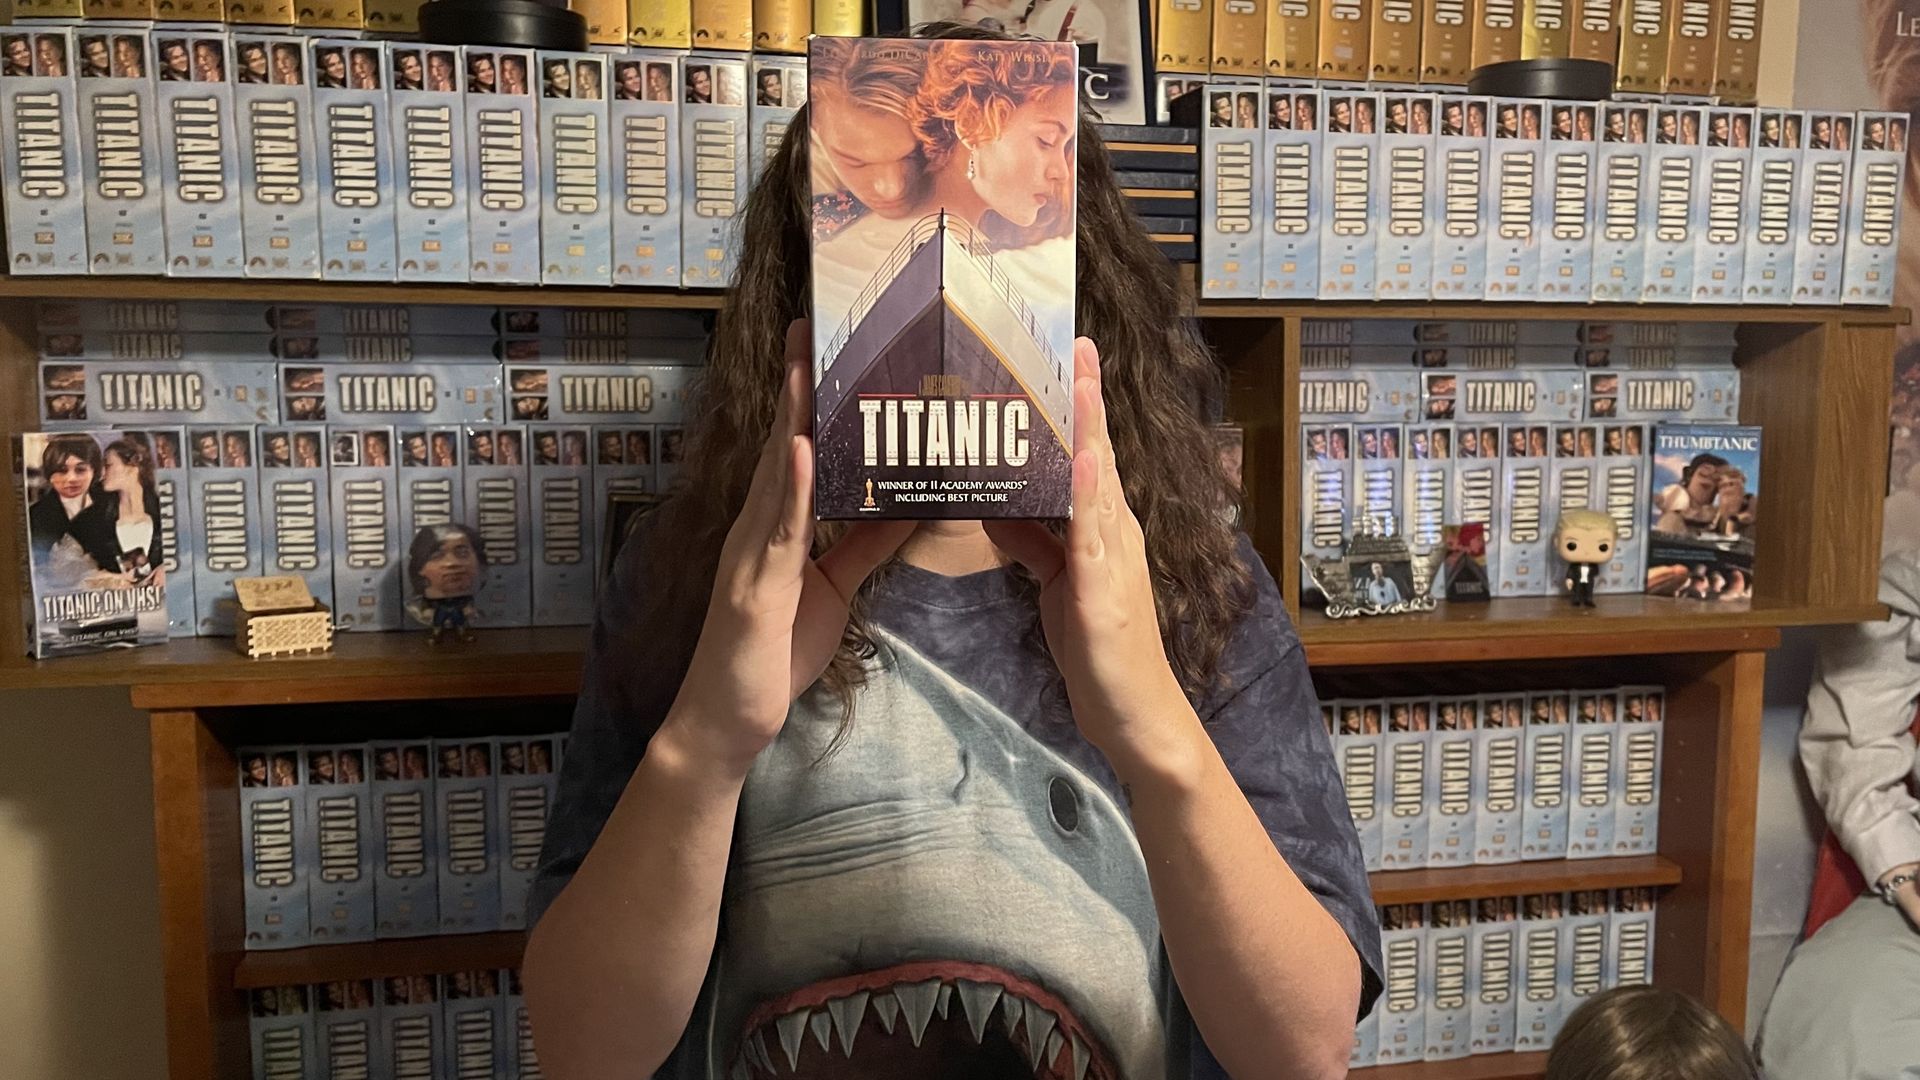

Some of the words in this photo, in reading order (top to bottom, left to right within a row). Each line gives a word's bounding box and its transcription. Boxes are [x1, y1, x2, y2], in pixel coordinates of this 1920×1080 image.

[16, 93, 66, 197] TITANIC
[94, 94, 145, 198] TITANIC
[173, 98, 224, 202] TITANIC
[251, 101, 301, 203] TITANIC
[329, 105, 379, 207] TITANIC
[407, 107, 453, 208] TITANIC
[479, 110, 524, 210] TITANIC
[554, 114, 598, 214] TITANIC
[625, 116, 668, 214] TITANIC
[695, 120, 736, 217] TITANIC
[1216, 142, 1252, 233] TITANIC
[1274, 143, 1310, 234] TITANIC
[1333, 147, 1369, 235] TITANIC
[1390, 147, 1425, 235] TITANIC
[1445, 150, 1480, 237] TITANIC
[1500, 152, 1534, 238] TITANIC
[1553, 153, 1588, 239] TITANIC
[1605, 155, 1640, 241] TITANIC
[1657, 158, 1691, 241] TITANIC
[1709, 160, 1743, 243] TITANIC
[1759, 161, 1793, 243] TITANIC
[1810, 162, 1844, 244] TITANIC
[1862, 163, 1897, 244] TITANIC
[100, 374, 203, 411] TITANIC
[339, 375, 434, 412] TITANIC
[561, 375, 652, 412] TITANIC
[859, 400, 1029, 467] TITANIC
[1299, 382, 1368, 412] TITANIC
[1466, 381, 1535, 411] TITANIC
[1627, 380, 1693, 410] TITANIC
[1660, 435, 1758, 451] THUMBTANIC
[203, 480, 248, 570] TITANIC
[275, 481, 317, 570] TITANIC
[345, 480, 385, 569] TITANIC
[412, 480, 450, 534] TITA
[542, 478, 581, 564] TITANIC
[878, 481, 914, 490] WINNER
[916, 481, 928, 490] OF
[940, 481, 983, 490] ACADEMY
[895, 493, 945, 502] INCLUDING
[948, 493, 969, 502] BEST
[971, 493, 1008, 502] PICTURE
[1314, 470, 1343, 547] TITANIC
[1414, 470, 1443, 545] TITANIC
[1510, 467, 1541, 543] TITANIC
[1561, 468, 1589, 513] TITA
[43, 592, 100, 621] TITANIC
[104, 590, 123, 615] ON
[127, 585, 161, 612] VHS!
[1393, 743, 1424, 816] TITANIC
[1440, 740, 1471, 814] TITANIC
[1487, 738, 1517, 811] TITANIC
[1533, 734, 1564, 807] TITANIC
[1580, 733, 1610, 805] TITANIC
[1626, 731, 1656, 804] TITANIC
[252, 799, 293, 886] TITANIC
[320, 797, 358, 881] TITANIC
[385, 792, 423, 876] TITANIC
[449, 790, 485, 873] TITANIC
[510, 787, 545, 870] TITANIC
[1387, 939, 1417, 1012] TITANIC
[1436, 936, 1465, 1009] TITANIC
[1481, 932, 1511, 1003] TITANIC
[1528, 929, 1557, 1000] TITANIC
[1573, 925, 1601, 996] TITANIC
